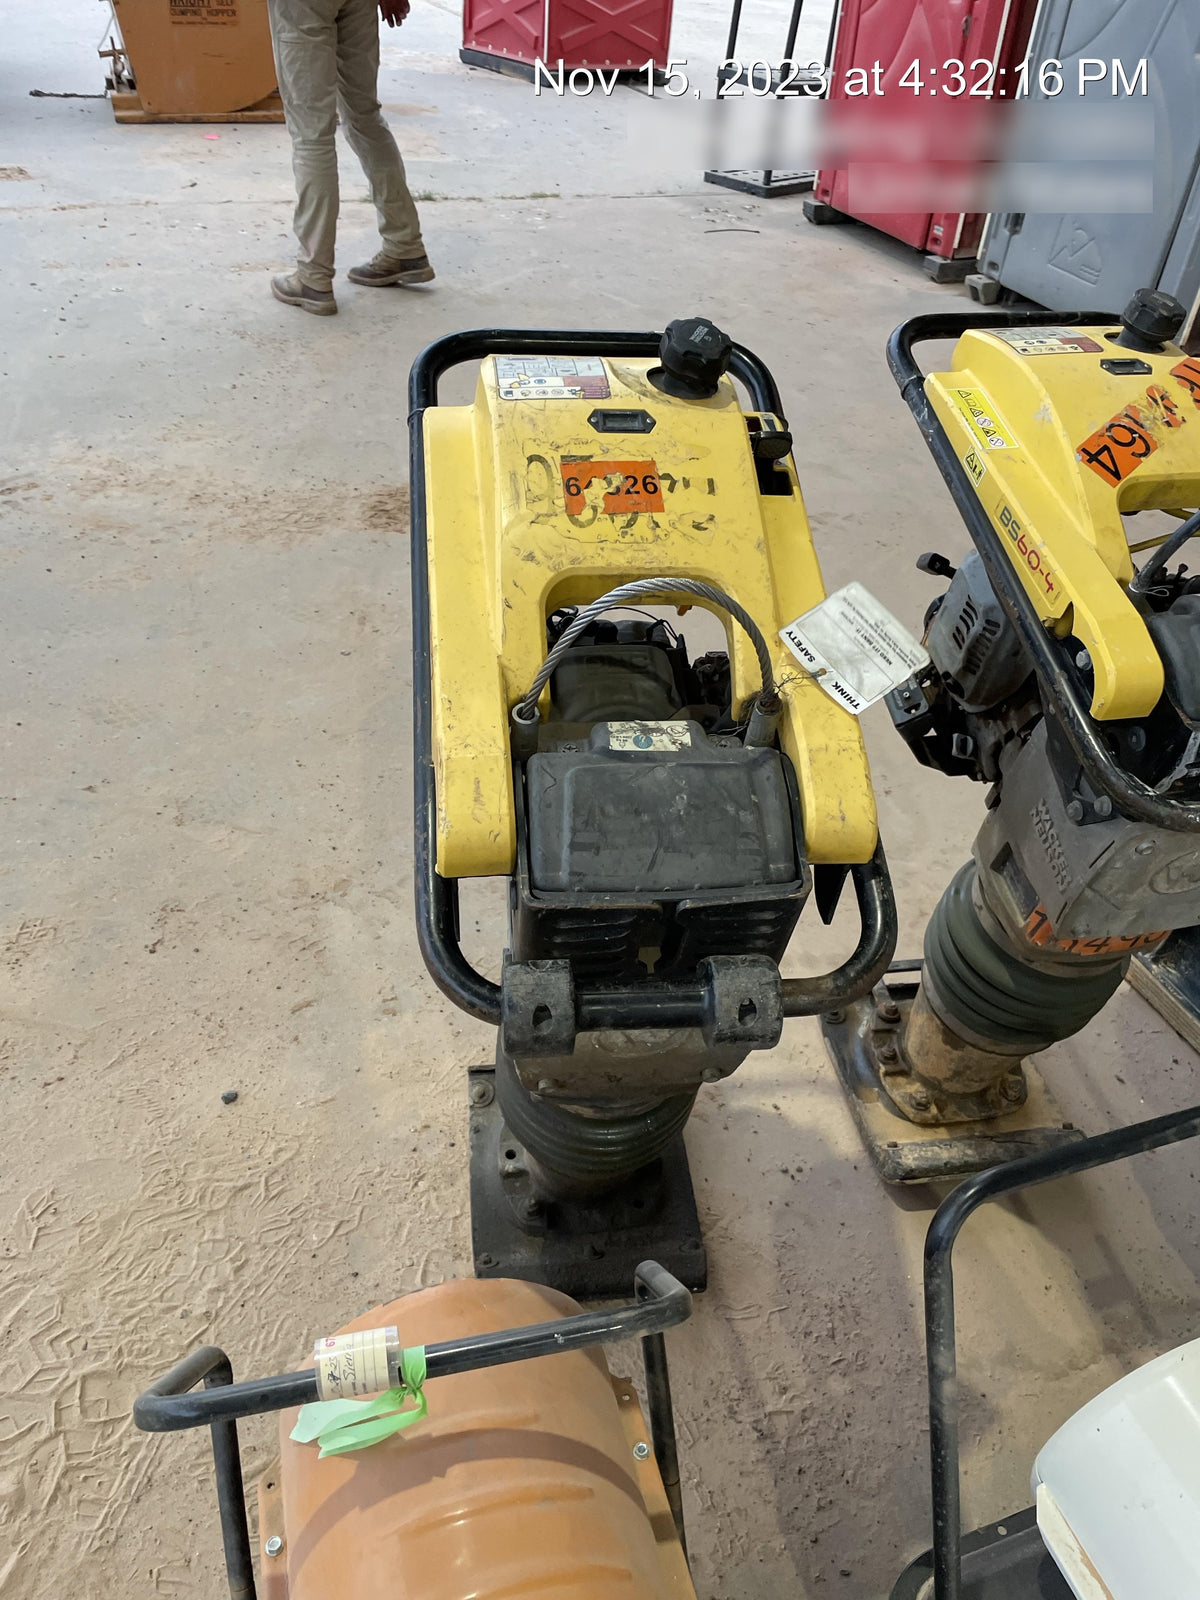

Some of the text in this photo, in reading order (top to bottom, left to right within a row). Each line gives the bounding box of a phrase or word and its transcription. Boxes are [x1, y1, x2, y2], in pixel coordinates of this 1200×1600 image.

[1000, 506, 1054, 593] BS60-4
[785, 630, 861, 710] THINK SAFETY
